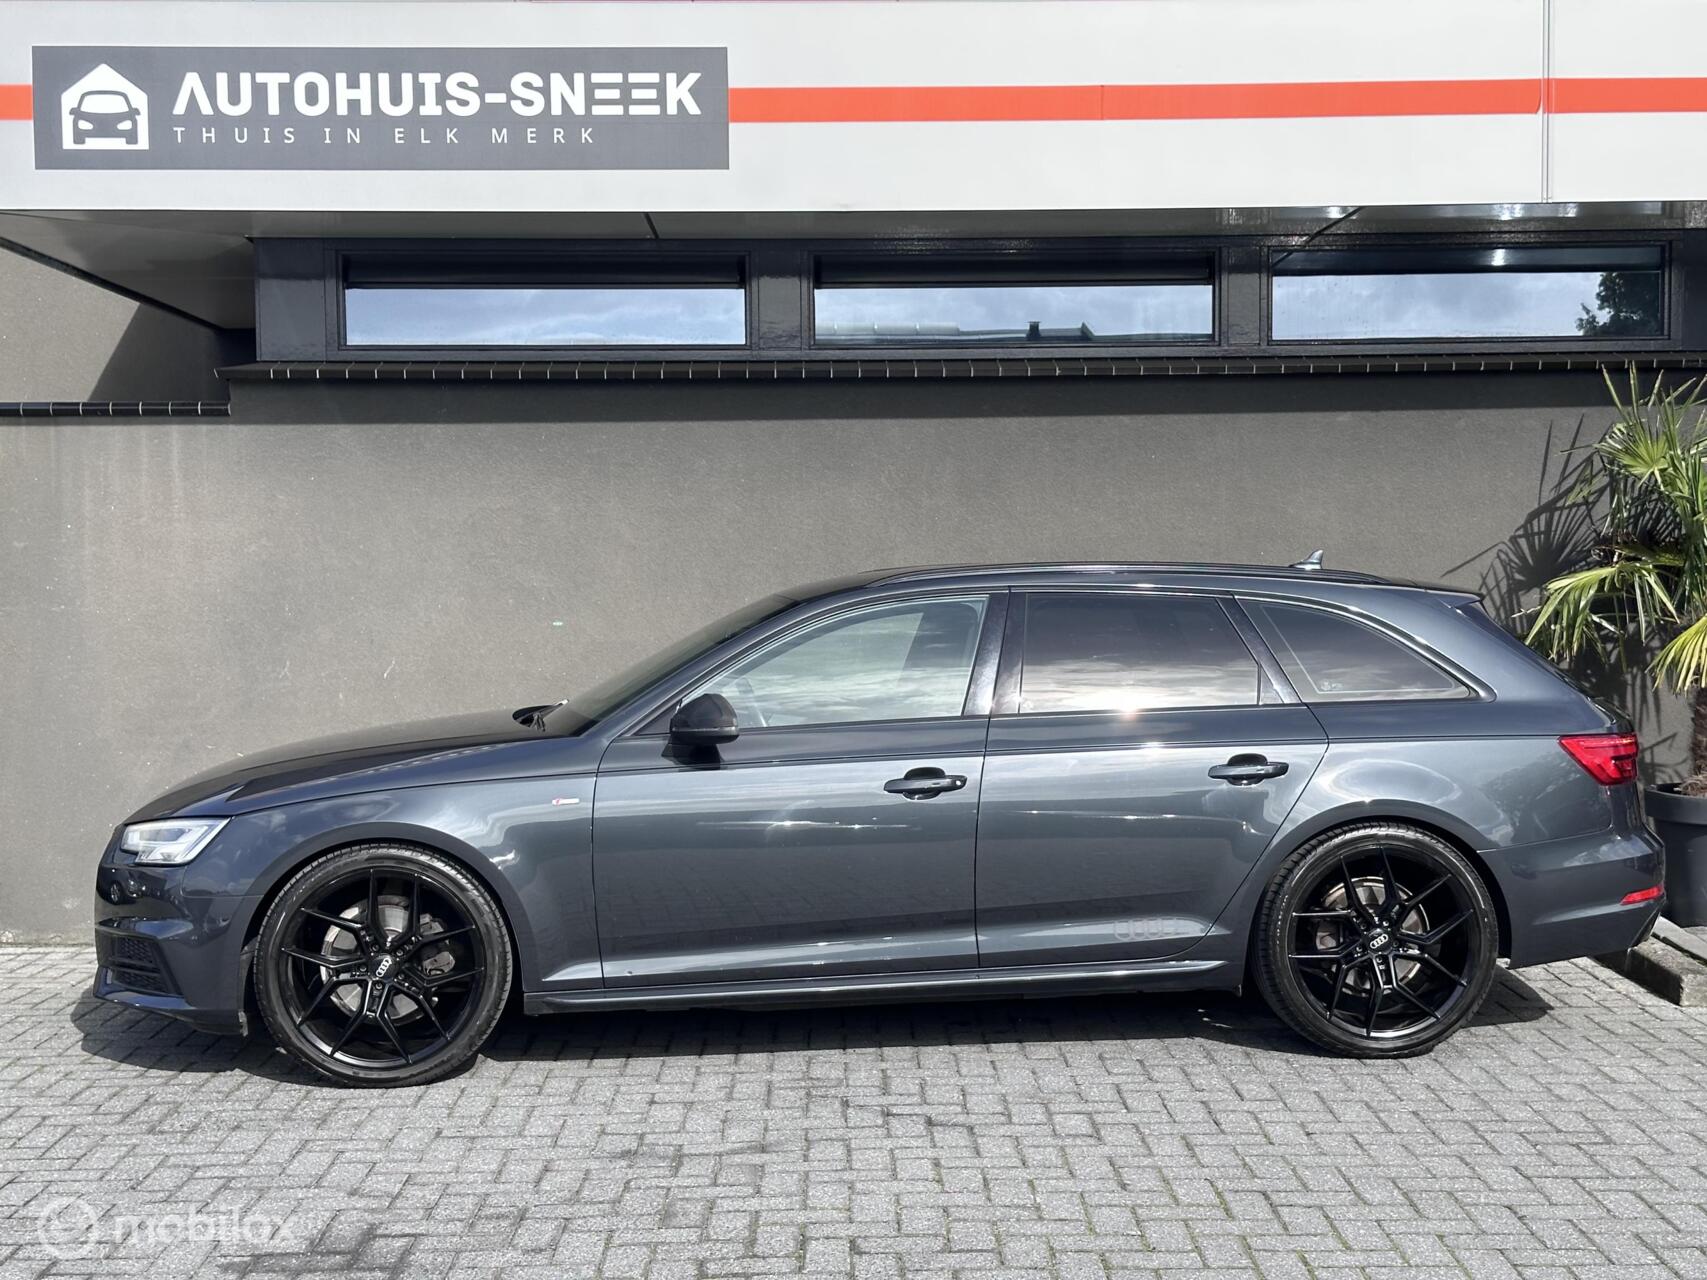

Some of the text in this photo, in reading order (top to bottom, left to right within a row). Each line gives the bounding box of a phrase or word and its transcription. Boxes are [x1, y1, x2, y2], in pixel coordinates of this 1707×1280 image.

[172, 71, 701, 117] AUTOHUIS-SNEEK
[172, 126, 593, 144] THUIS IN ELK MERK
